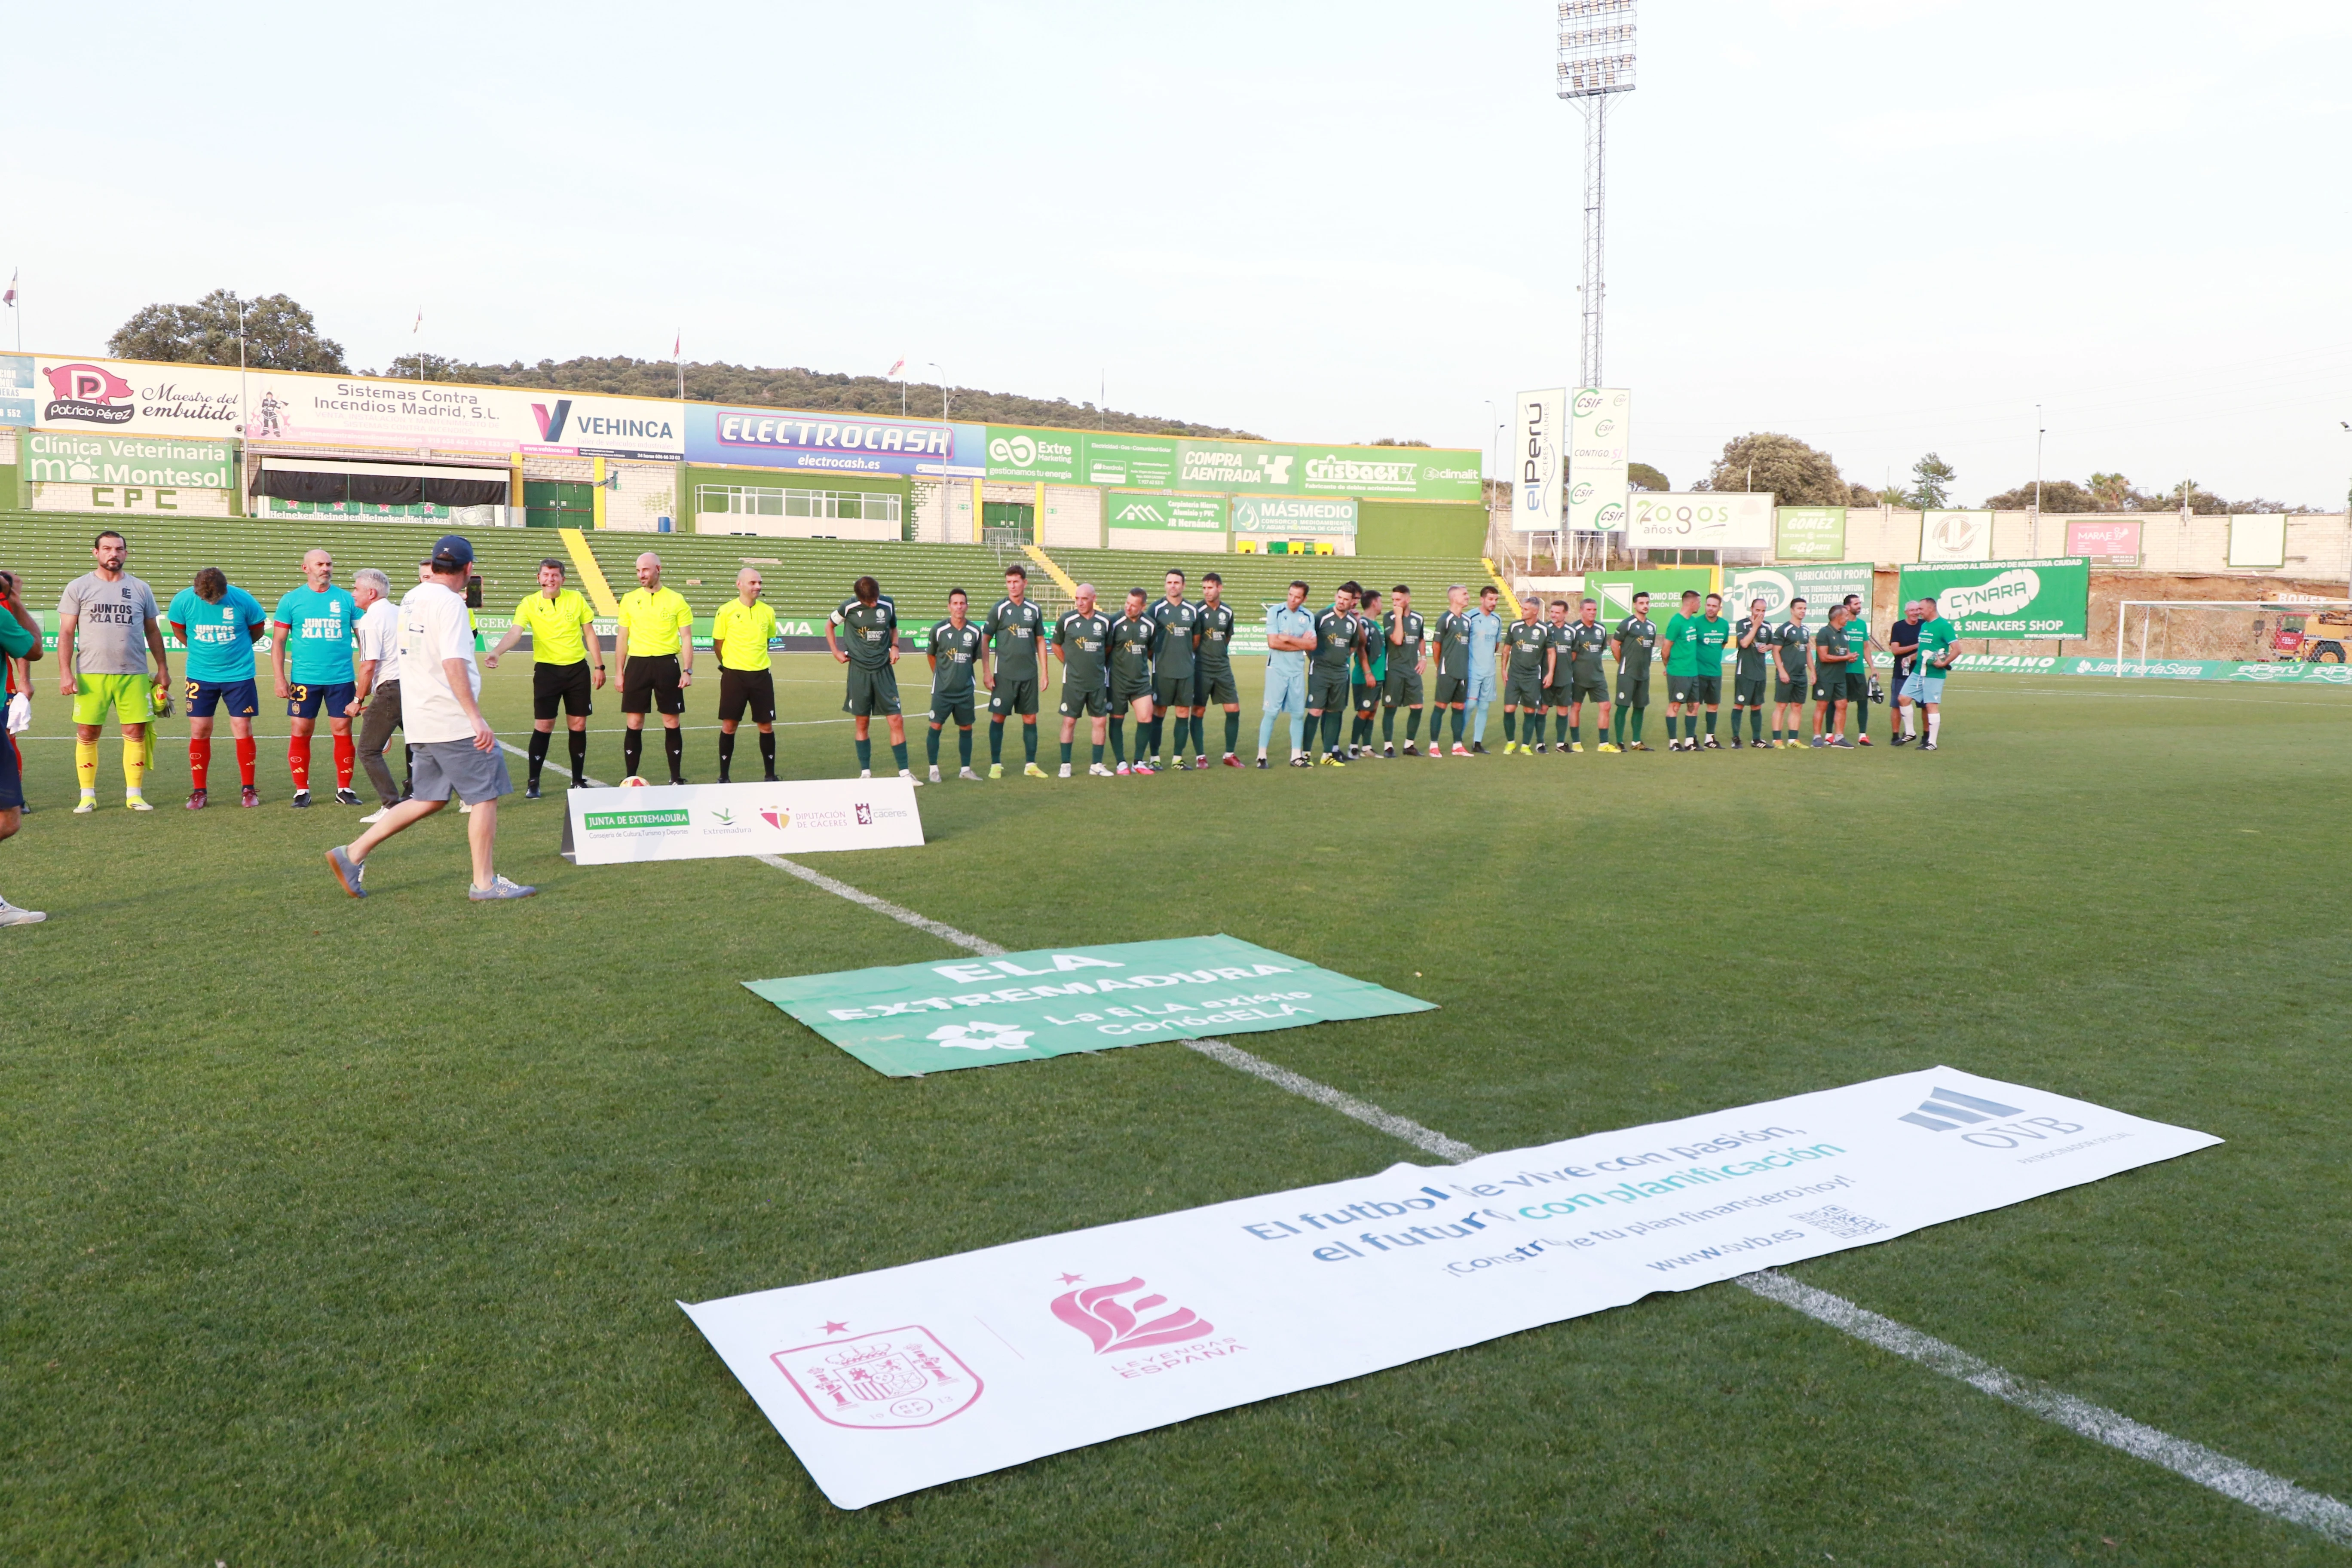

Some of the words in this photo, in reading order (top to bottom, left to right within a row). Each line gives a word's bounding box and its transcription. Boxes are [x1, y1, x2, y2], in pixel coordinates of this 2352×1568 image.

[142, 383, 212, 404] Maestro
[217, 389, 239, 405] del
[337, 384, 416, 400] Sistemas
[422, 390, 478, 404] Contra
[315, 396, 395, 413] Incendios
[402, 402, 466, 419] Madrid,
[472, 407, 500, 420] S.L.
[1576, 398, 1604, 408] CSIF
[7, 408, 21, 418] 552
[50, 404, 94, 418] Patricio
[96, 408, 131, 421] Pérez
[142, 402, 239, 421] embutido
[343, 421, 389, 429] SISTEMAS
[391, 424, 426, 432] CONTRA
[428, 425, 474, 435] INCENDIOS
[577, 416, 673, 439] VEHINCA
[722, 417, 949, 454] ELECTROCASH
[31, 436, 102, 456] Clínica
[109, 439, 226, 461] Veterinaria
[638, 441, 674, 450] industriales
[1038, 441, 1072, 455] Extre
[1038, 453, 1072, 464] Marketing
[1185, 450, 1243, 467] COMPRA
[1524, 402, 1543, 511] elPerú
[1574, 449, 1610, 459] CONTIGO,
[798, 454, 881, 470] electrocash.es
[1305, 454, 1399, 481] Crisbaex
[104, 462, 227, 488] Montesol
[989, 467, 1035, 477] gestionamos
[1045, 469, 1072, 480] energía
[1182, 466, 1261, 484] LAENTRADA
[1439, 469, 1479, 480] climalit
[1574, 489, 1595, 497] CSIF
[1168, 500, 1199, 508] Carpintería
[1200, 502, 1220, 510] Hierro,
[1261, 500, 1353, 519] MÁSMEDIO
[270, 511, 315, 520] Heineken
[316, 512, 361, 521] Heineken
[362, 514, 406, 523] Heineken
[407, 515, 450, 524] Heineken
[1600, 511, 1626, 522] CSIF
[1167, 518, 1177, 527] JR
[1178, 518, 1219, 529] Hernández
[1644, 523, 1672, 534] años
[1787, 517, 1836, 530] GOMEZ
[2078, 531, 2113, 541] MARAJE
[1795, 567, 1844, 581] FABRICACIÓN
[1844, 569, 1872, 580] PROPIA
[1903, 564, 1932, 572] SIEMPRE
[1841, 584, 1865, 592] PINTURA
[1951, 581, 2027, 609] CYNARA
[1746, 588, 1779, 607] MAYO
[2278, 593, 2327, 607] BONET
[90, 603, 132, 614] JUNTOS
[89, 613, 111, 623] XLA
[115, 614, 134, 625] ELA
[302, 618, 342, 629] JUNTOS
[1954, 622, 1963, 631] &
[1965, 621, 2026, 631] SNEAKERS
[2029, 620, 2063, 631] SHOP
[193, 624, 234, 634] JUNTOS
[301, 628, 322, 638] XLA
[325, 628, 343, 639] ELA
[194, 632, 214, 642] XLA
[216, 632, 236, 642] ELA
[2238, 663, 2306, 674] elPerú
[186, 681, 199, 699] 22
[290, 683, 307, 702] 23
[588, 816, 615, 828] JUNTA
[617, 815, 627, 824] DE
[629, 813, 688, 824] EXTREMADURA
[796, 810, 846, 820] DIPUTACIÓN
[703, 826, 752, 835] Extremadura
[810, 819, 848, 828] CÁCERES
[931, 954, 1126, 984] ELA
[827, 963, 1294, 1021] EXTREMADURA
[1044, 1012, 1104, 1026] La
[1105, 1003, 1199, 1017] ELA
[1200, 990, 1313, 1009] existe
[1096, 1003, 1314, 1035] ConócELA
[1960, 1117, 2085, 1149] OVB
[2016, 1139, 2096, 1165] PATROCINADOR
[1241, 1221, 1303, 1240] El
[1500, 1165, 1596, 1189] vive
[1595, 1150, 1674, 1173] con
[1667, 1124, 1807, 1160] pasión,
[1312, 1241, 1366, 1262] el
[1359, 1211, 1517, 1252] futuro
[1518, 1189, 1608, 1220] con
[1601, 1141, 1848, 1204] planificación
[1588, 1228, 1629, 1241] tu
[1624, 1215, 1686, 1236] plan
[1679, 1188, 1804, 1227] financiero
[1797, 1173, 1857, 1194] hoy!
[1645, 1227, 1806, 1273] www.ovb.es
[1111, 1338, 1237, 1371] LEYENDAS
[1120, 1344, 1249, 1379] ESPAÑA
